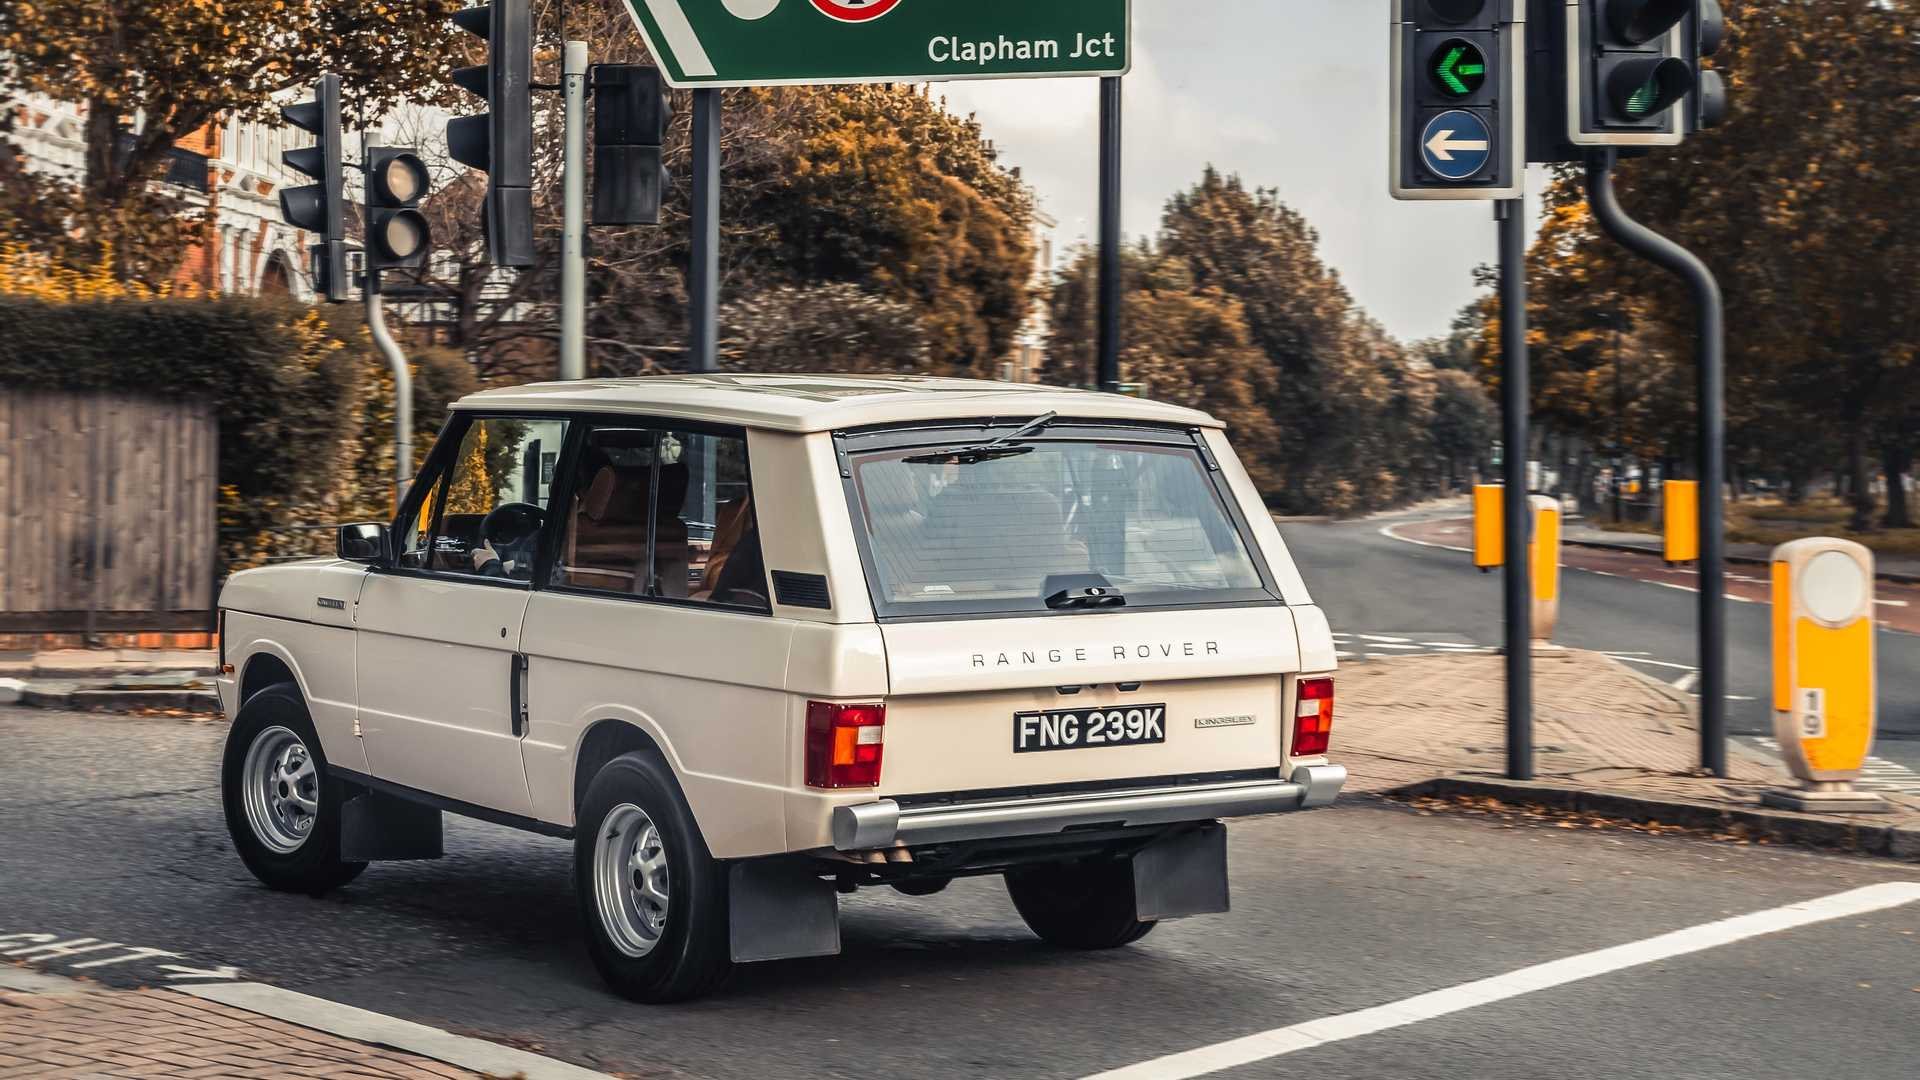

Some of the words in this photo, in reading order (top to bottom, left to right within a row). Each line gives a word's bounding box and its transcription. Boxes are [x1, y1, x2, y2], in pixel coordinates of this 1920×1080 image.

[928, 34, 1058, 65] Clapham
[1069, 32, 1115, 58] Jct
[971, 648, 1087, 668] RANGE
[1112, 641, 1219, 660] ROVER
[1018, 713, 1080, 748] FNG
[1086, 707, 1164, 744] 239K
